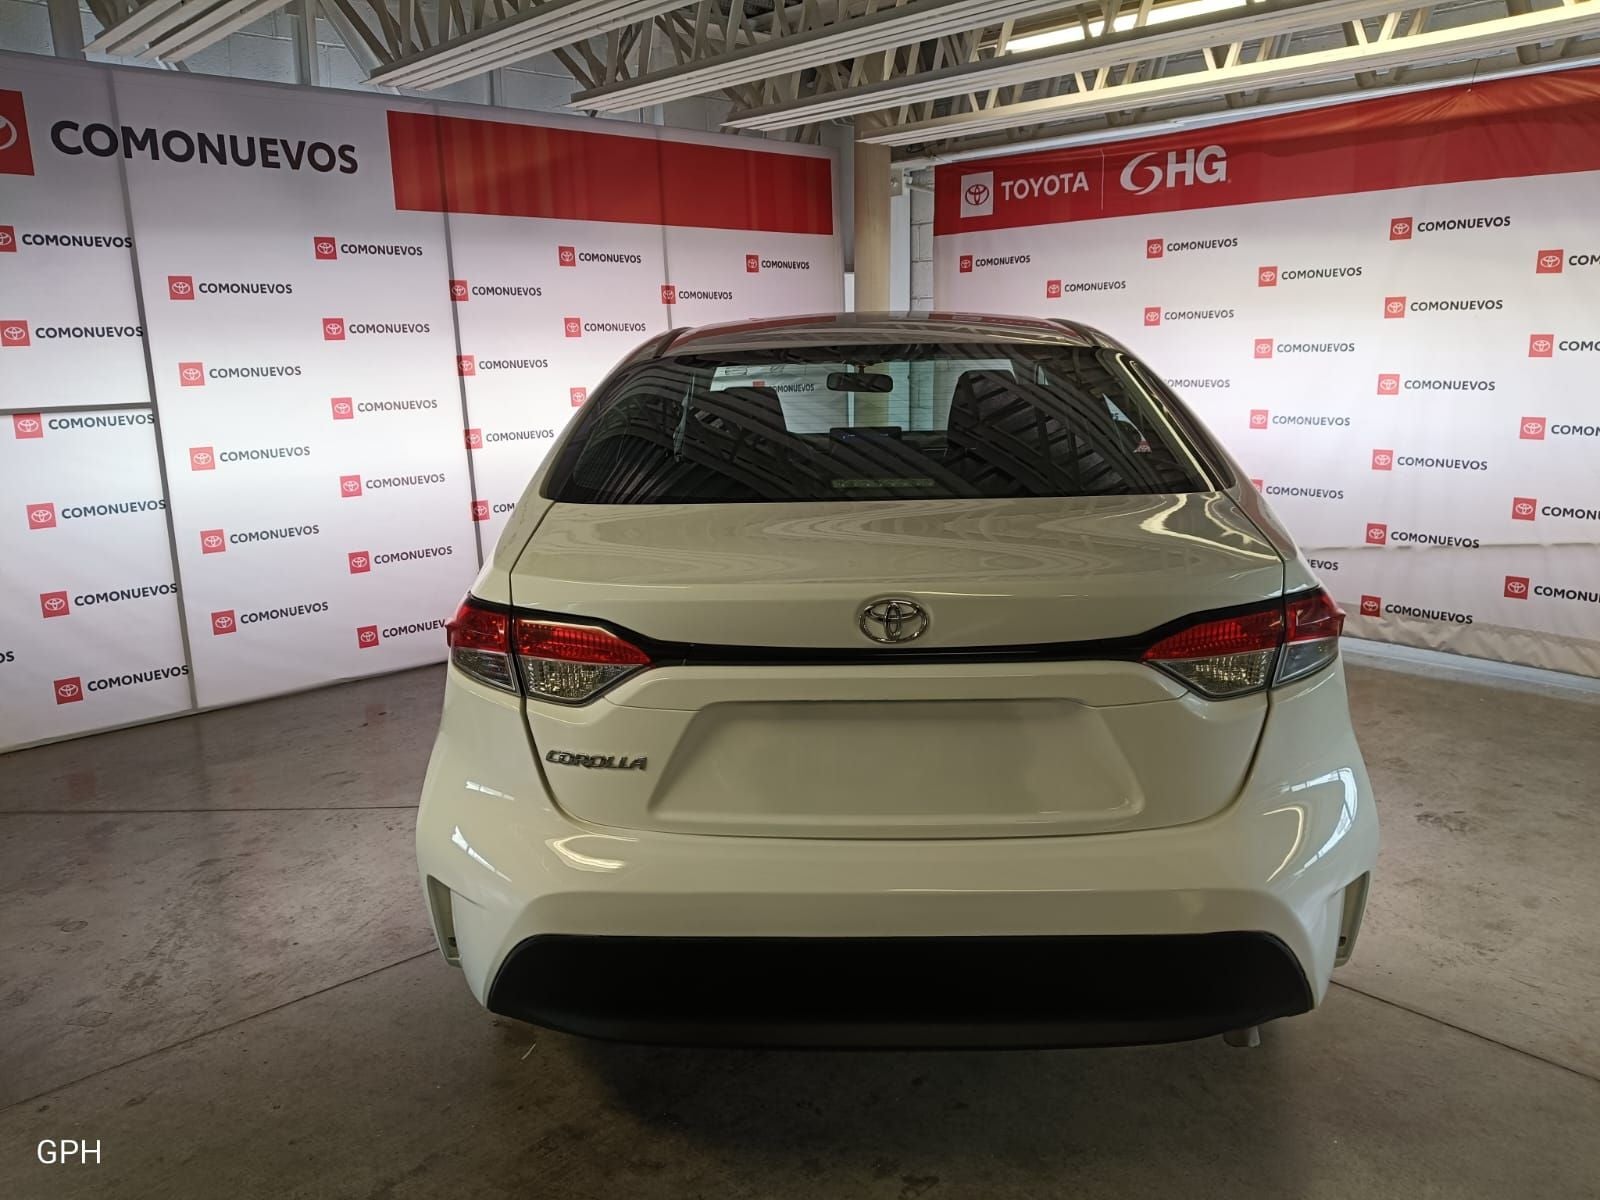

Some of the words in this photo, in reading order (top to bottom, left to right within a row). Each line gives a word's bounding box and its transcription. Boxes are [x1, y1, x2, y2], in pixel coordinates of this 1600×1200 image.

[50, 120, 358, 175] COMONUEVOS
[1001, 171, 1089, 201] TOYOTA
[1417, 215, 1511, 233] COMONUEVOS
[22, 233, 133, 249] COMONUEVOS
[1167, 238, 1238, 252] COMONUEVOS
[340, 243, 423, 256] COMONUEVOS
[578, 251, 642, 264] COMONUEVOS
[975, 255, 1031, 267] COMONUEVOS
[761, 259, 810, 271] COMONUEVOS
[1281, 266, 1362, 280] COMONUEVOS
[198, 282, 293, 294] COMONUEVOS
[471, 286, 542, 297] COMONUEVOS
[1064, 280, 1126, 293] COMONUEVOS
[678, 290, 733, 301] COMONUEVOS
[1410, 299, 1503, 312] COMONUEVOS
[1164, 309, 1235, 321] COMONUEVOS
[35, 325, 144, 341] COMONUEVOS
[348, 323, 431, 334] COMONUEVOS
[584, 322, 647, 332] COMONUEVOS
[1277, 342, 1355, 353] COMONUEVOS
[478, 359, 549, 370] COMONUEVOS
[208, 366, 302, 379] COMONUEVOS
[1165, 379, 1230, 388] OMONUEVOS
[1404, 380, 1496, 391] COMONUEVOS
[357, 399, 438, 413] COMONUEVOS
[48, 413, 155, 431] COMONUEVOS
[1272, 415, 1351, 427] COMONUEVOS
[486, 429, 555, 442] COMONUEVOS
[219, 446, 311, 463] COMONUEVOS
[1397, 456, 1488, 471] COMONUEVOS
[365, 473, 446, 489] COMONUEVOS
[1266, 486, 1344, 500] COMONUEVOS
[61, 499, 166, 520] COMONUEVOS
[1541, 506, 1600, 521] COMON
[229, 524, 320, 544] COMONUEVOS
[1390, 531, 1480, 549] COMONUEVOS
[373, 545, 453, 565] COMONUEVOS
[1308, 559, 1339, 571] EVOS
[74, 583, 178, 606] COMONUEVOS
[1533, 585, 1600, 603] COMONU
[240, 601, 329, 625] COMONUEVOS
[1384, 604, 1473, 625] COMONUEVOS
[87, 665, 189, 691] COMONUEVOS
[546, 750, 648, 770] COROLLA
